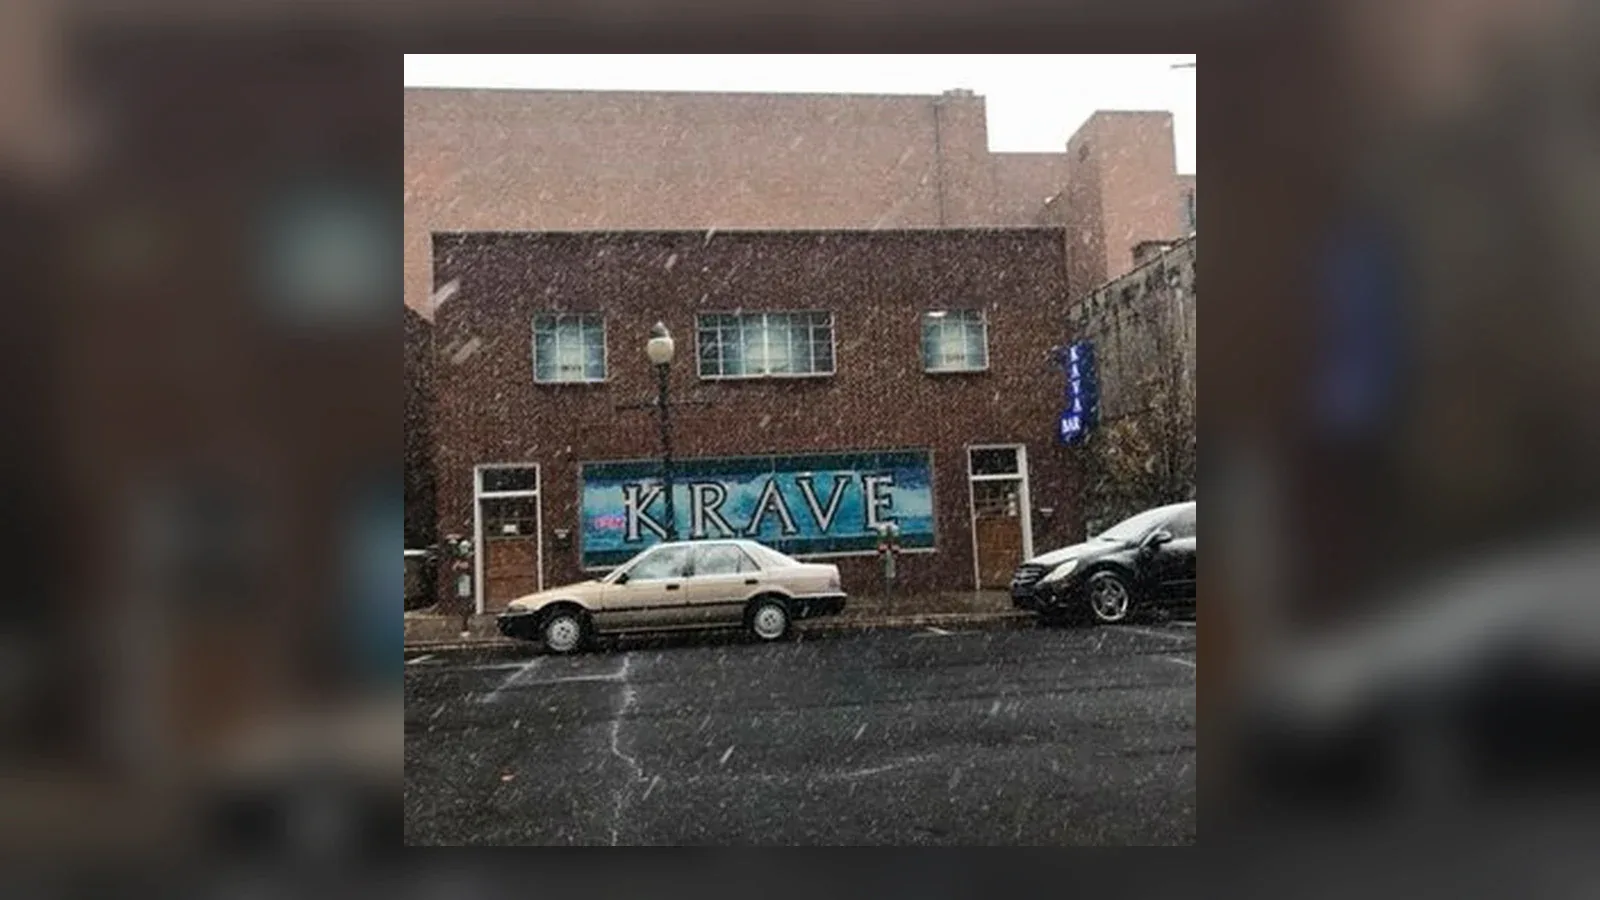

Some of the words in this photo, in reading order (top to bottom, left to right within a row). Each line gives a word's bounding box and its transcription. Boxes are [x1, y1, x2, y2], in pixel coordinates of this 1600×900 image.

[1069, 345, 1083, 413] KAVA
[1061, 415, 1081, 433] BAR
[622, 474, 899, 542] KRAVE
